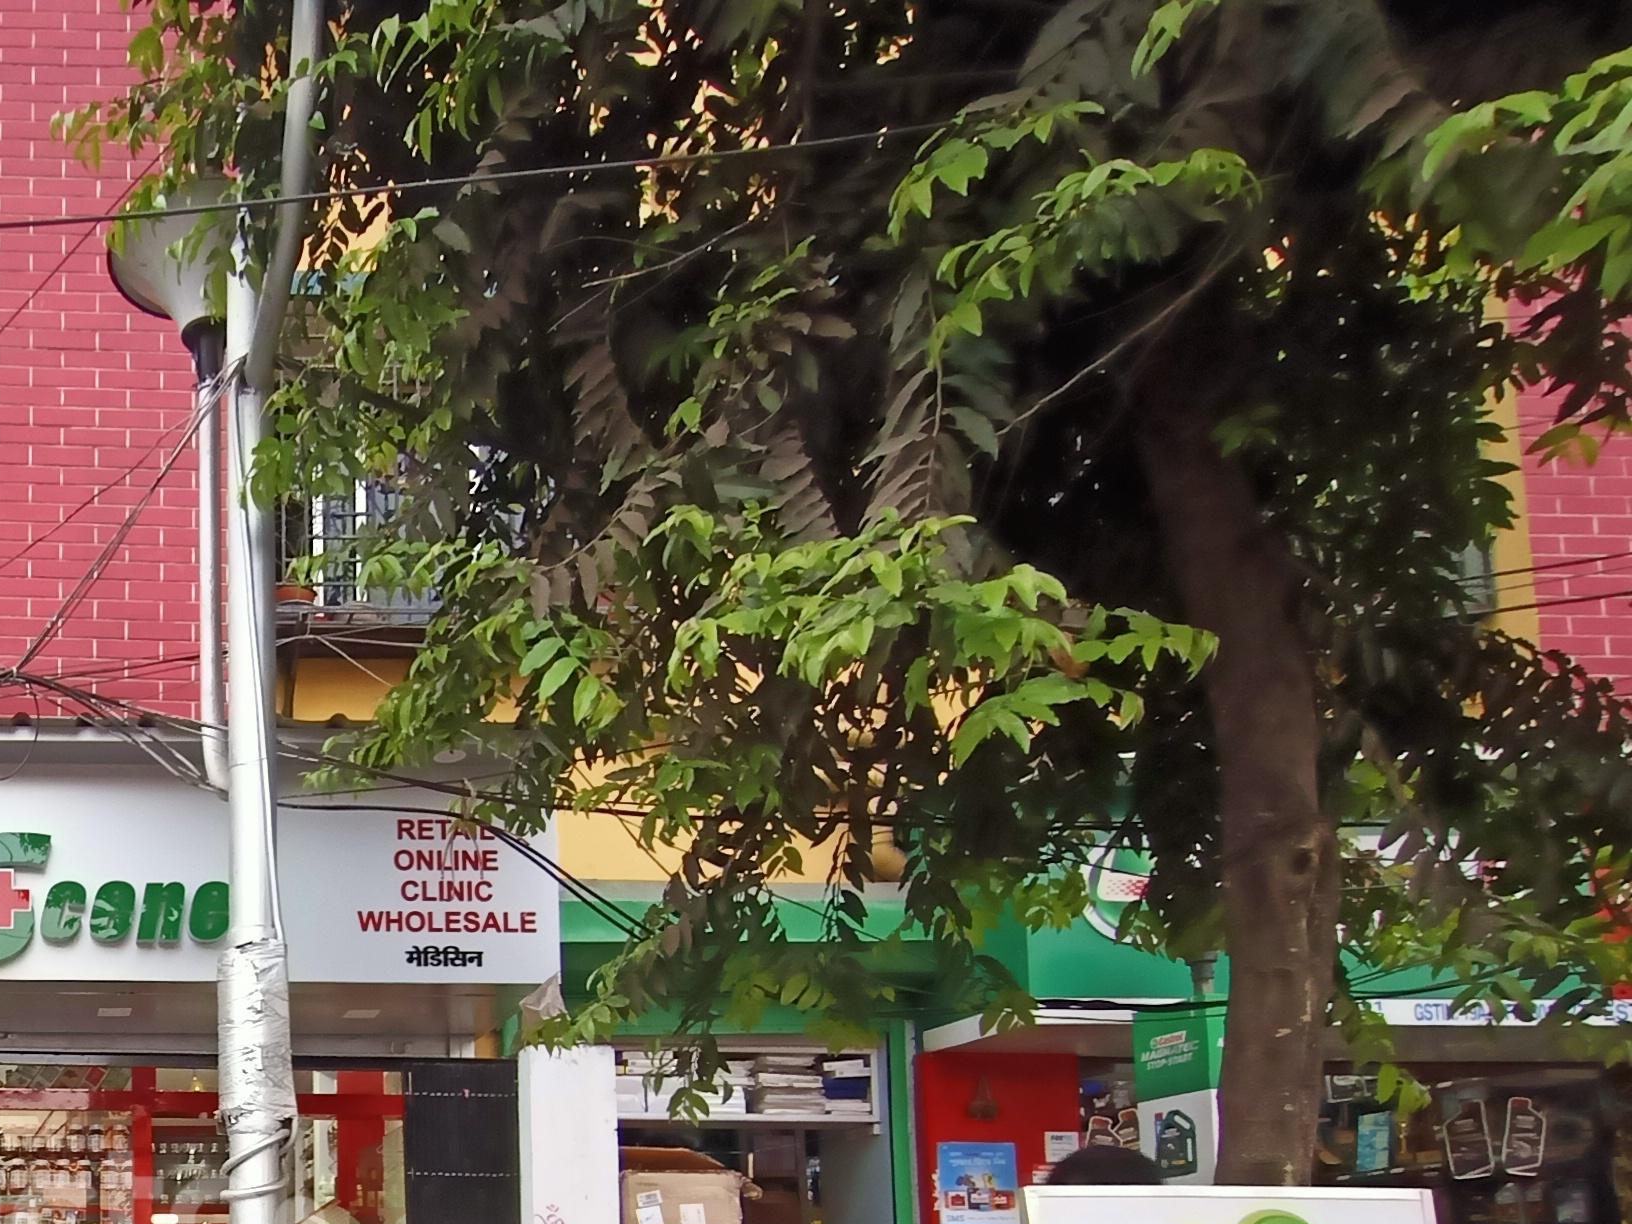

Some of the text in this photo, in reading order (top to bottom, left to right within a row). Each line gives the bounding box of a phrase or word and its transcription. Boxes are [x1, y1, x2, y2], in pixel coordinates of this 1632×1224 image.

[393, 849, 499, 871] ONLINE
[400, 880, 494, 902] CLINIC
[356, 911, 537, 933] WHOLESALE
[404, 945, 483, 968] मेडिसिन
